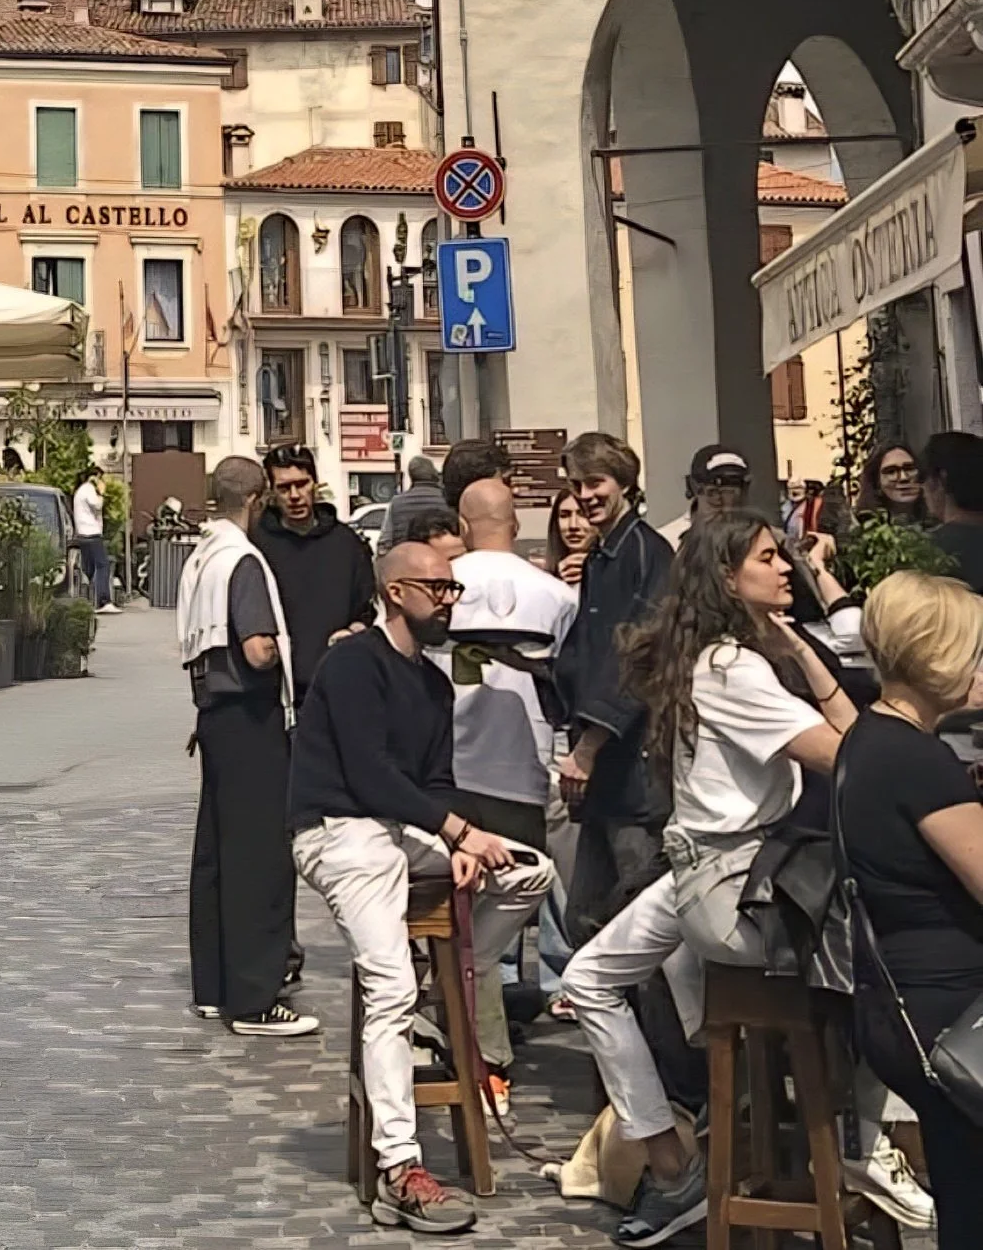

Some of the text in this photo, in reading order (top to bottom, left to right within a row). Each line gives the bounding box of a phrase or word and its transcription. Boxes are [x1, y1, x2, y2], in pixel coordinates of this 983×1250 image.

[22, 204, 51, 225] AL
[66, 205, 189, 227] CASTELLO
[456, 249, 492, 301] P
[852, 194, 938, 304] OSTERIA
